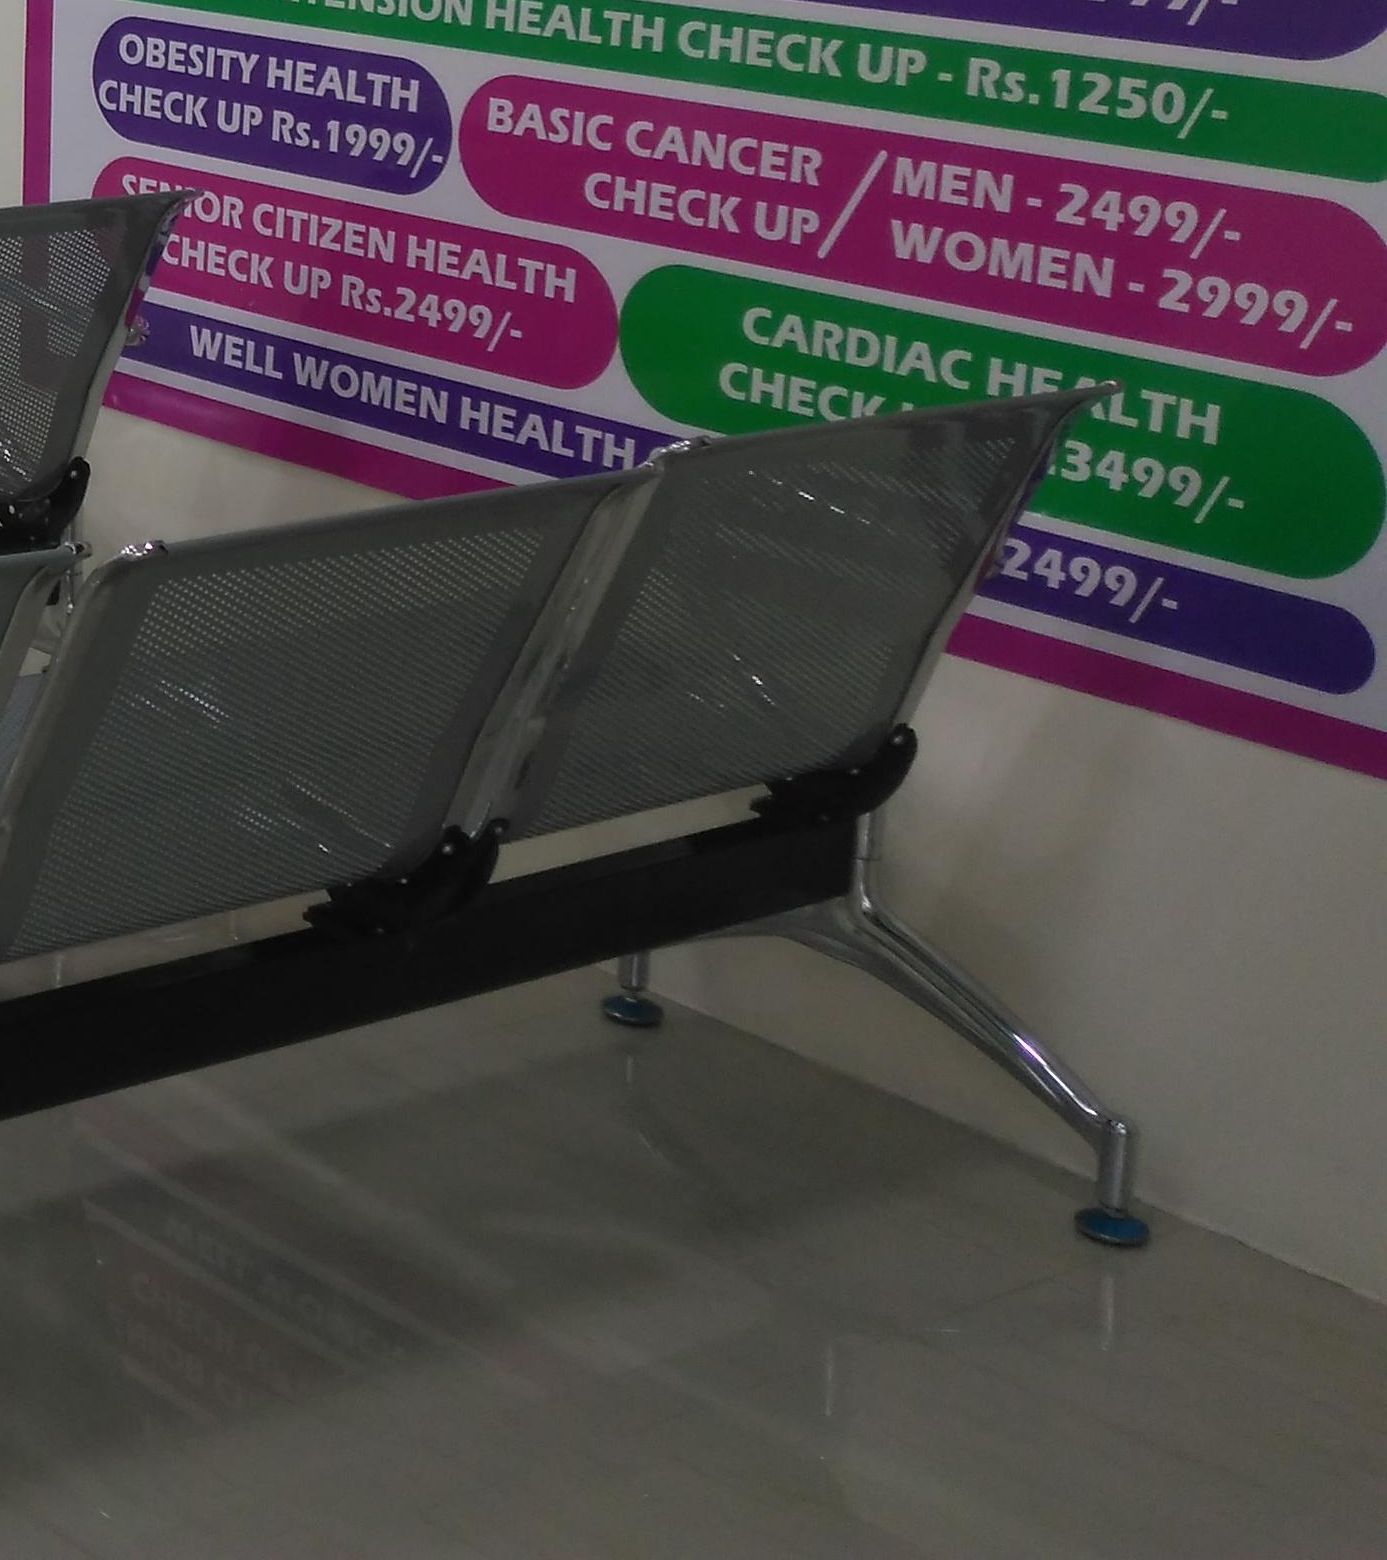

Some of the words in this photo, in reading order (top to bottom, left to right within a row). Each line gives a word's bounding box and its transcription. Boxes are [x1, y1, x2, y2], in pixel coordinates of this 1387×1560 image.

[119, 33, 259, 85] OBESITY
[266, 55, 420, 113] HEALTH
[677, 20, 845, 78] CHECK
[856, 42, 927, 87] UP
[965, 58, 1229, 139] Rs.1250/-
[98, 78, 207, 128] CHECK
[216, 94, 264, 138] UP
[271, 114, 445, 179] Rs.1999/-
[487, 96, 614, 151] BASIC
[625, 117, 823, 186] CANCER
[252, 202, 395, 265] CITIZEN
[406, 238, 577, 304] HEALTH
[583, 172, 740, 234] CHECK
[754, 202, 820, 245] UP
[892, 156, 1014, 211] MEN
[1054, 183, 1242, 259] 2499/-
[162, 233, 274, 290] CHECK
[283, 260, 331, 302] UP
[340, 275, 523, 352] Rs.2499/-
[890, 219, 1114, 298] WOMEN
[1158, 269, 1353, 349] 2999/-
[189, 325, 283, 380] WELL
[292, 350, 450, 425] WOMEN
[458, 395, 635, 471] HEALTH
[718, 361, 885, 422] CHECK
[742, 307, 972, 390] CARDIAC
